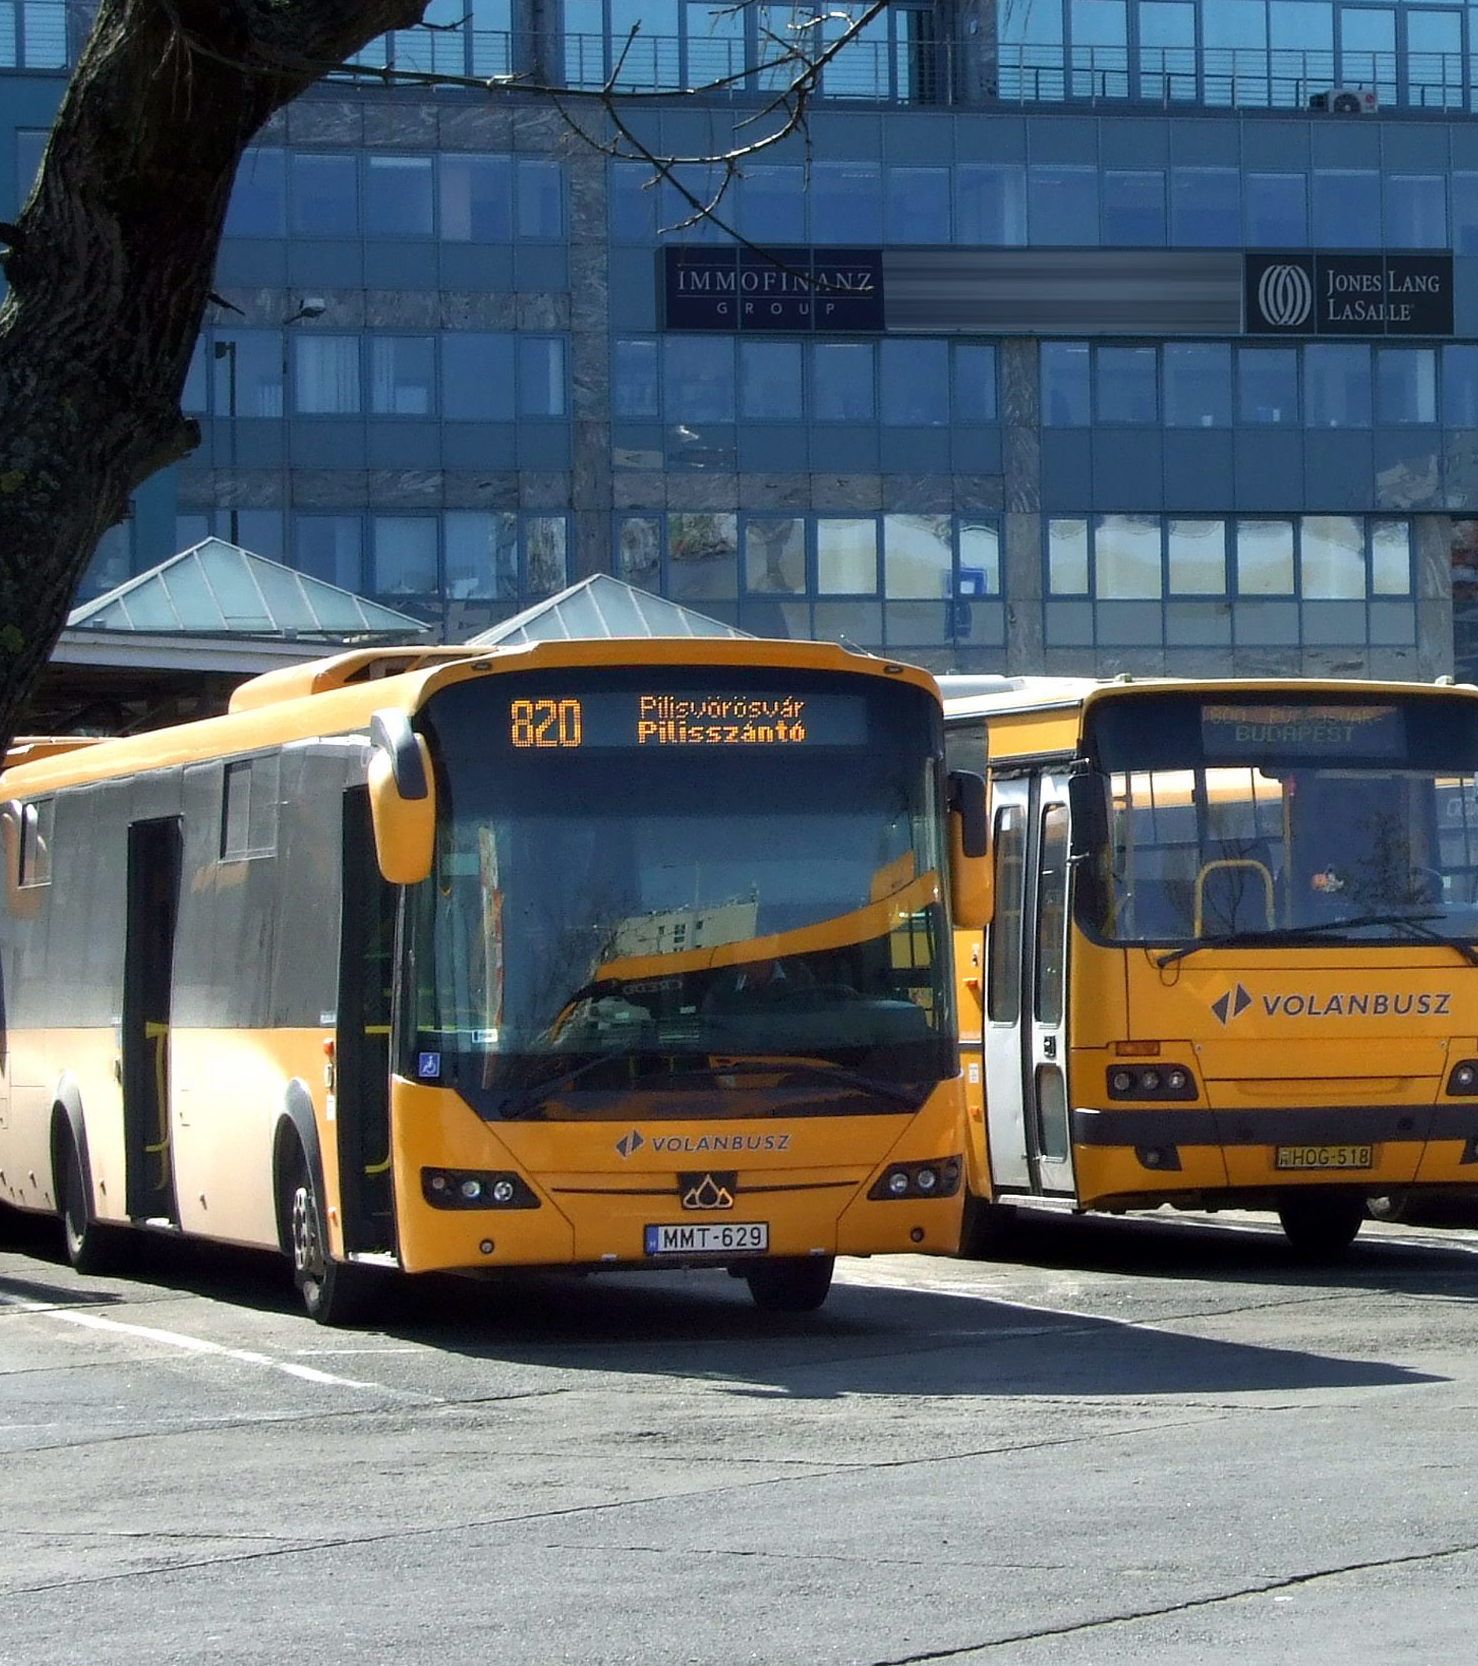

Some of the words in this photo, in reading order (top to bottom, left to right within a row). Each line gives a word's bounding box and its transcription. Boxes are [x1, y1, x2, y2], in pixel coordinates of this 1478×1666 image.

[676, 270, 873, 292] IMMOFINANZ
[716, 302, 836, 315] GROUP
[639, 695, 806, 719] Pilisvörösvár
[510, 699, 582, 748] 820
[637, 720, 808, 744] Pilisszántó
[1235, 726, 1354, 743] BUDAPEST
[1291, 1148, 1369, 1165] HOG-518
[663, 1226, 762, 1249] MMT-629
